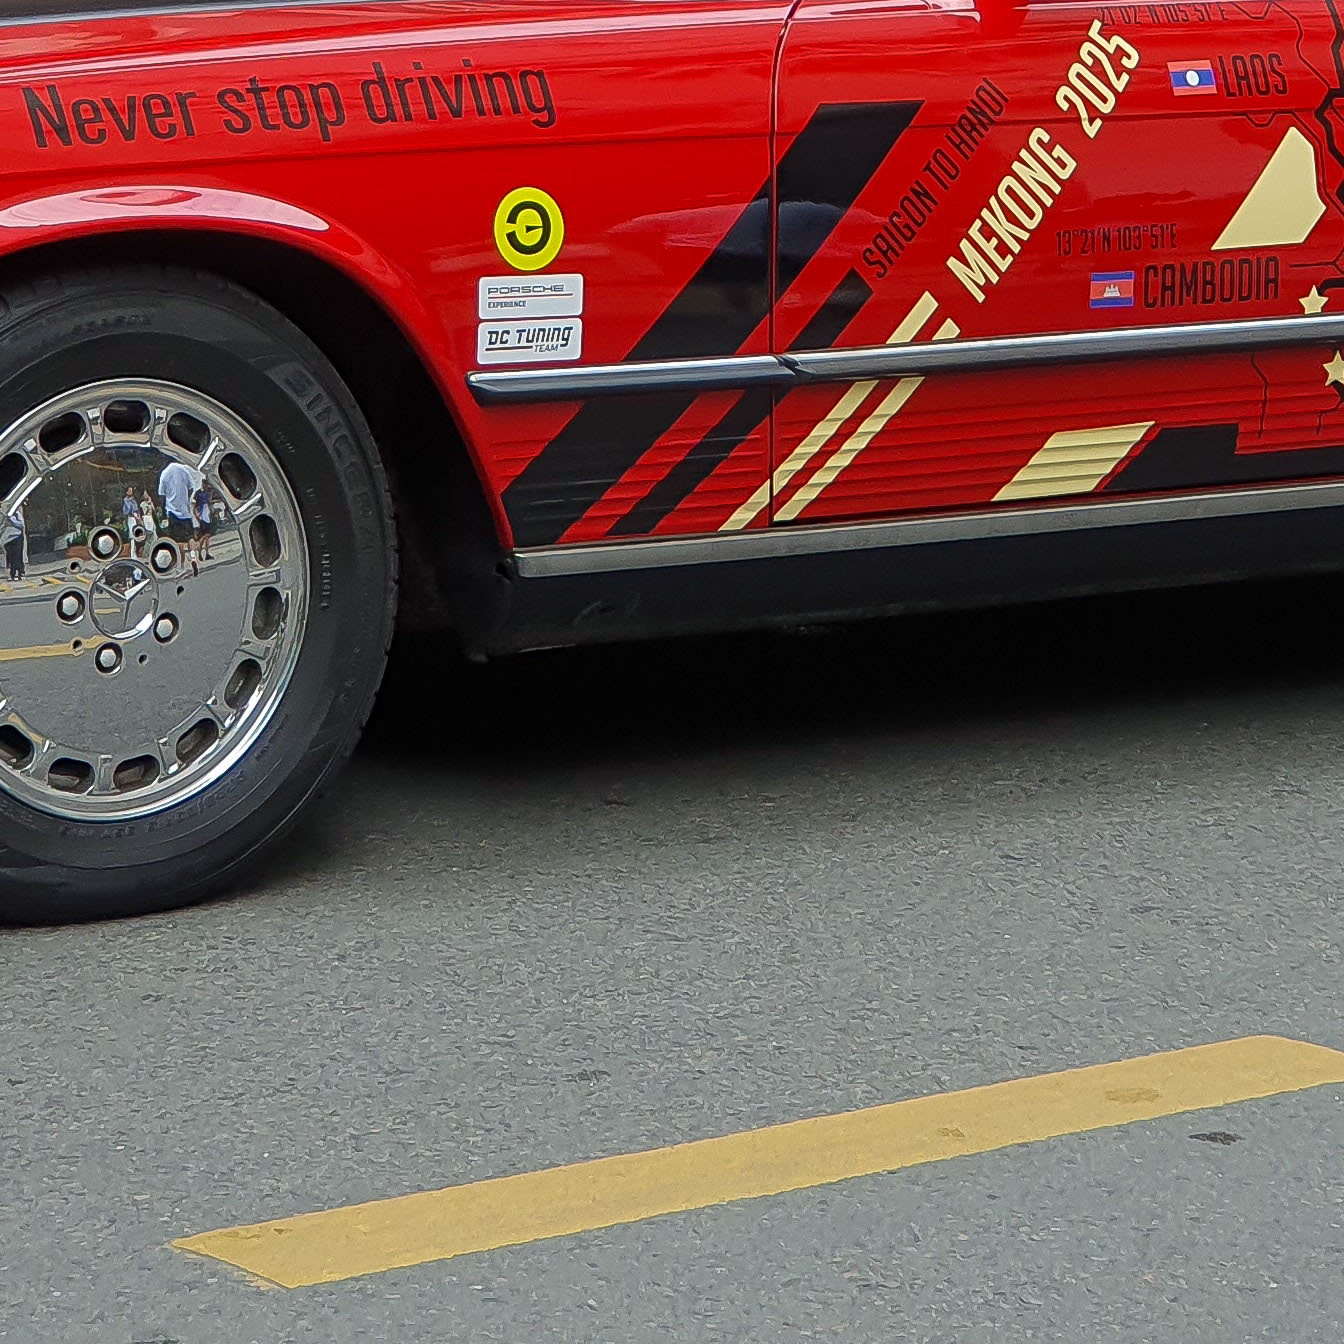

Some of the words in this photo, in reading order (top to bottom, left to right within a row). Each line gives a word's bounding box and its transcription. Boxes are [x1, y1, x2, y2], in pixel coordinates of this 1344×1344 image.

[1218, 53, 1289, 97] LAOS
[22, 84, 199, 148] Never
[217, 76, 345, 142] stop
[361, 59, 558, 128] driving
[862, 180, 939, 279] SAIGON
[923, 148, 960, 191] TO
[945, 77, 1010, 161] HANOI
[945, 127, 1078, 304] MEKONG
[1055, 19, 1141, 139] 2025
[488, 284, 565, 296] PORSCHE
[488, 299, 527, 309] EXPERIENCE
[1143, 256, 1280, 309] CAMBODIA
[487, 330, 511, 346] DC
[534, 344, 559, 353] TEAM
